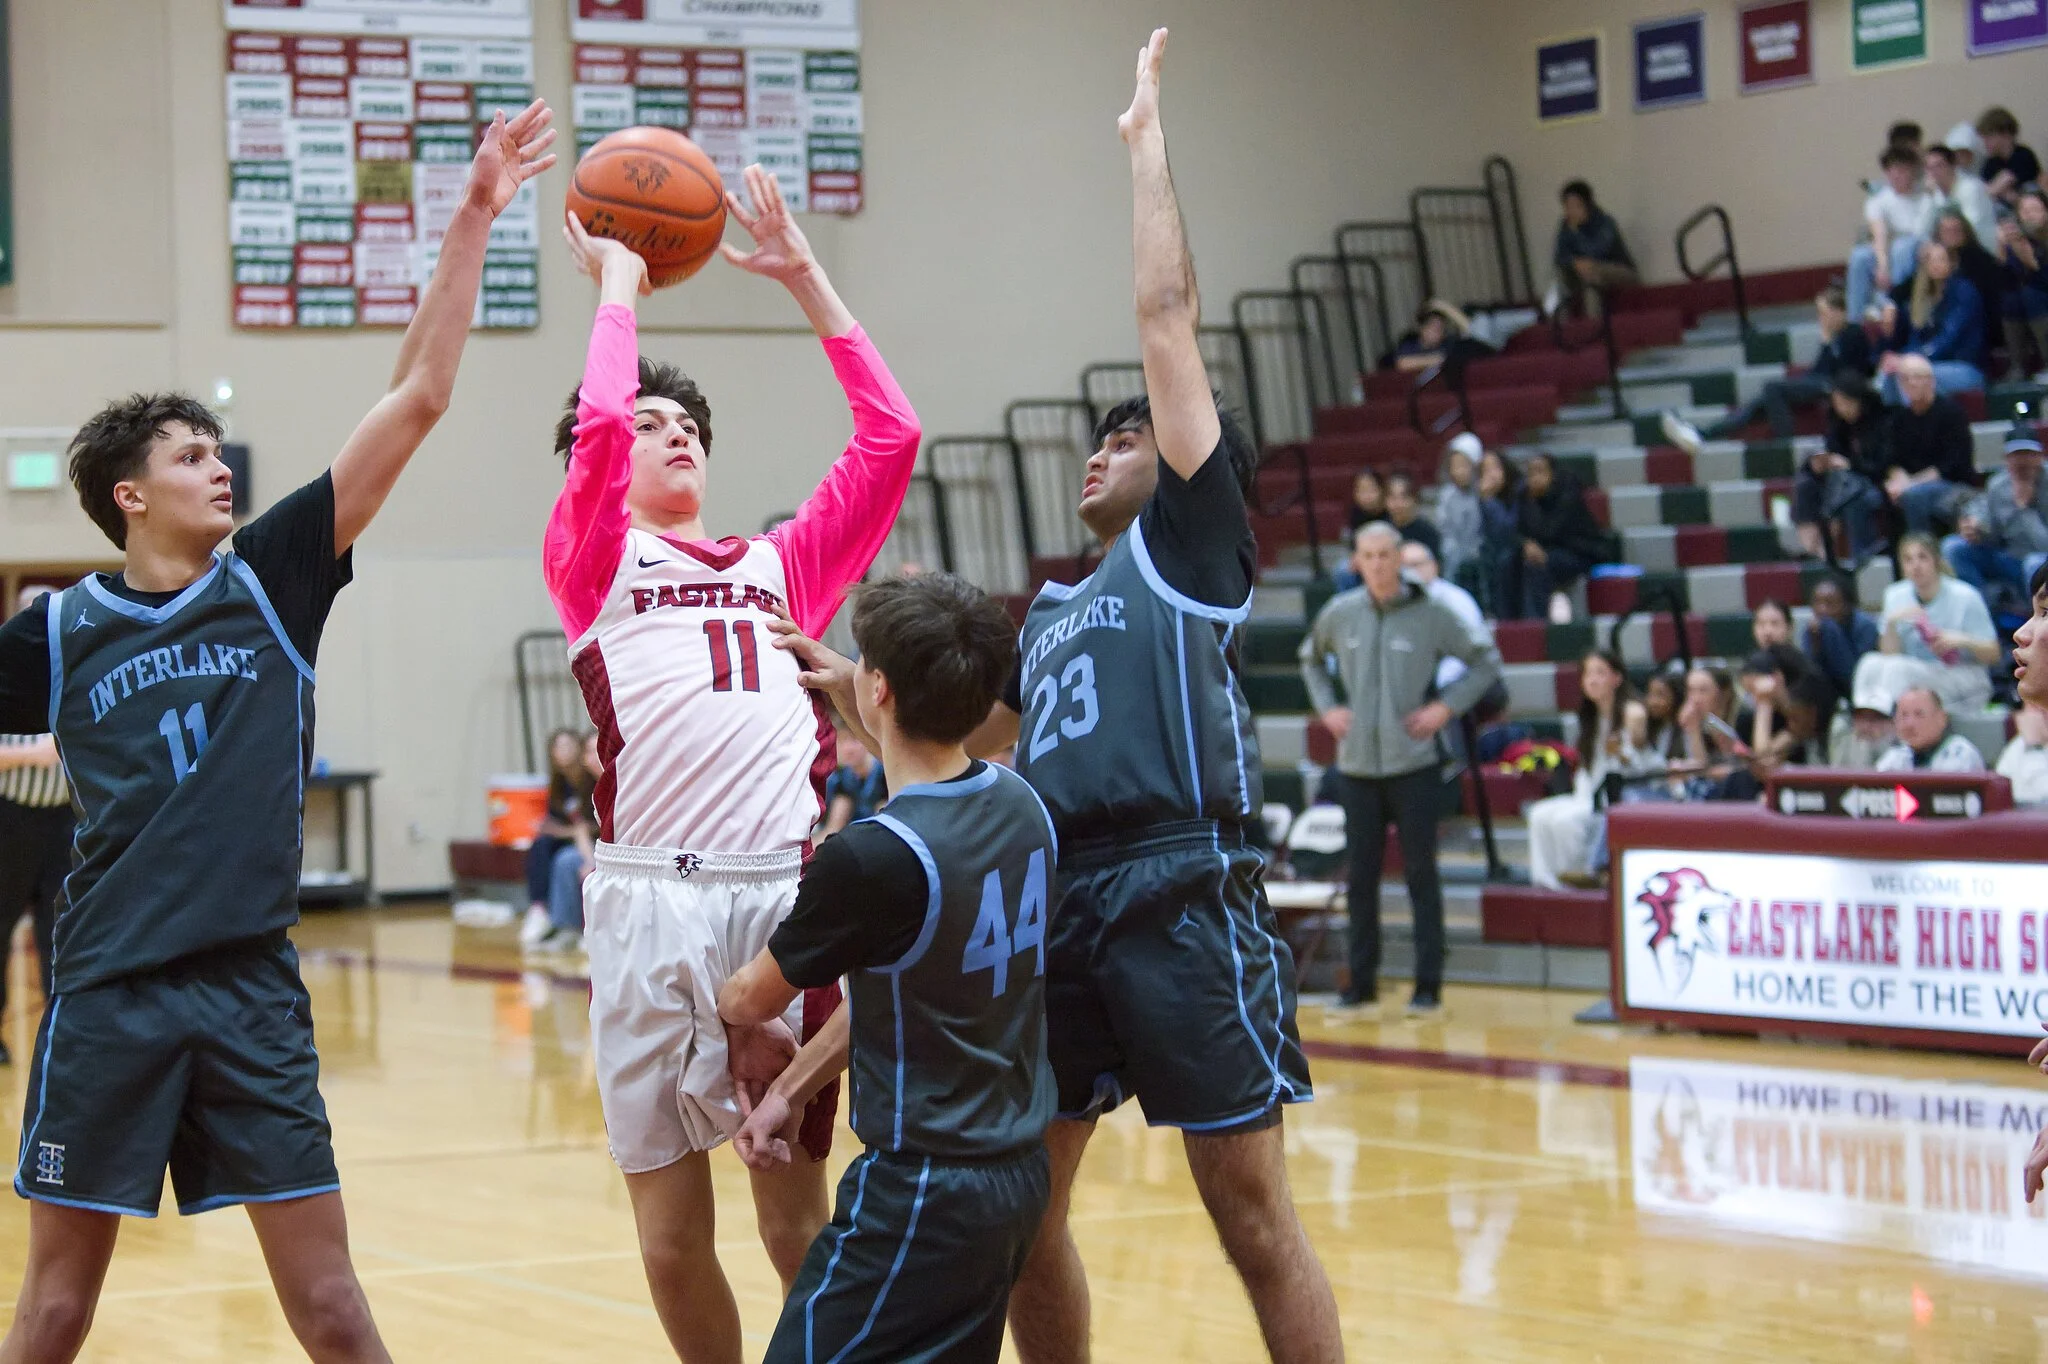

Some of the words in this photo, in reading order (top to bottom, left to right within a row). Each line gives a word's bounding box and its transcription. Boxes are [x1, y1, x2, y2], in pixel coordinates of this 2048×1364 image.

[632, 582, 781, 616] EASTLAK
[88, 643, 257, 724] INTERLAKE
[703, 619, 760, 693] 11
[1020, 596, 1127, 703] NTERLAKE
[158, 701, 210, 785] 11
[1029, 653, 1100, 764] 23
[962, 847, 1047, 999] 44
[1871, 874, 1962, 897] WELCOME
[1971, 878, 1995, 897] TO
[1728, 899, 1899, 967] EASTLAKE
[1915, 906, 2002, 973] HIGH
[1734, 971, 1838, 1009] HOME
[1851, 977, 1897, 1010] OF
[1910, 979, 1982, 1017] THE
